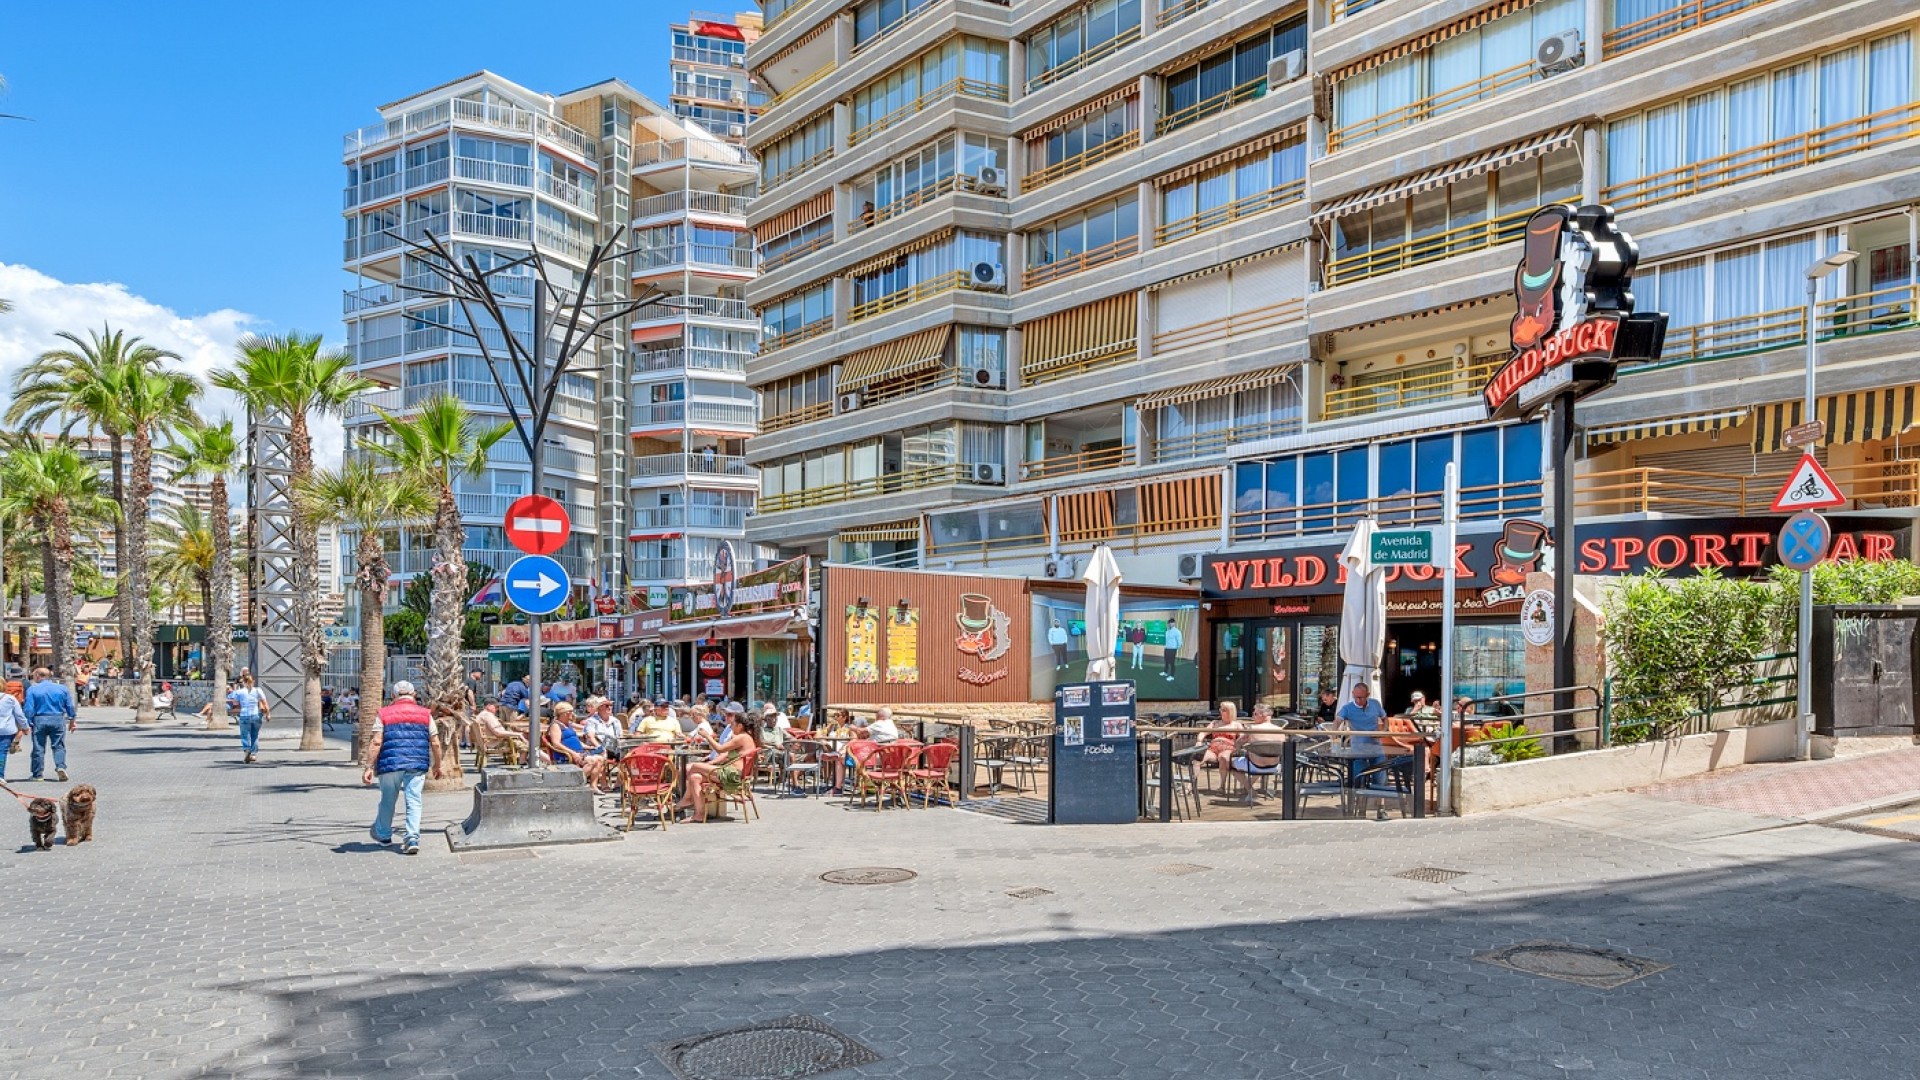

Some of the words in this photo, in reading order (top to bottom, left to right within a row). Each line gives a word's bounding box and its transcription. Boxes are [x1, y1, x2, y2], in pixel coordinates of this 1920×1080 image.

[1485, 348, 1538, 408] WILD
[1543, 319, 1616, 367] DUCK
[1379, 535, 1423, 546] Avenida
[1374, 551, 1389, 560] de
[1391, 548, 1430, 560] Madrid
[1579, 532, 1771, 573] SPORT
[1211, 555, 1328, 592] WILD
[1407, 600, 1427, 611] pub
[958, 666, 1009, 684] Welcome
